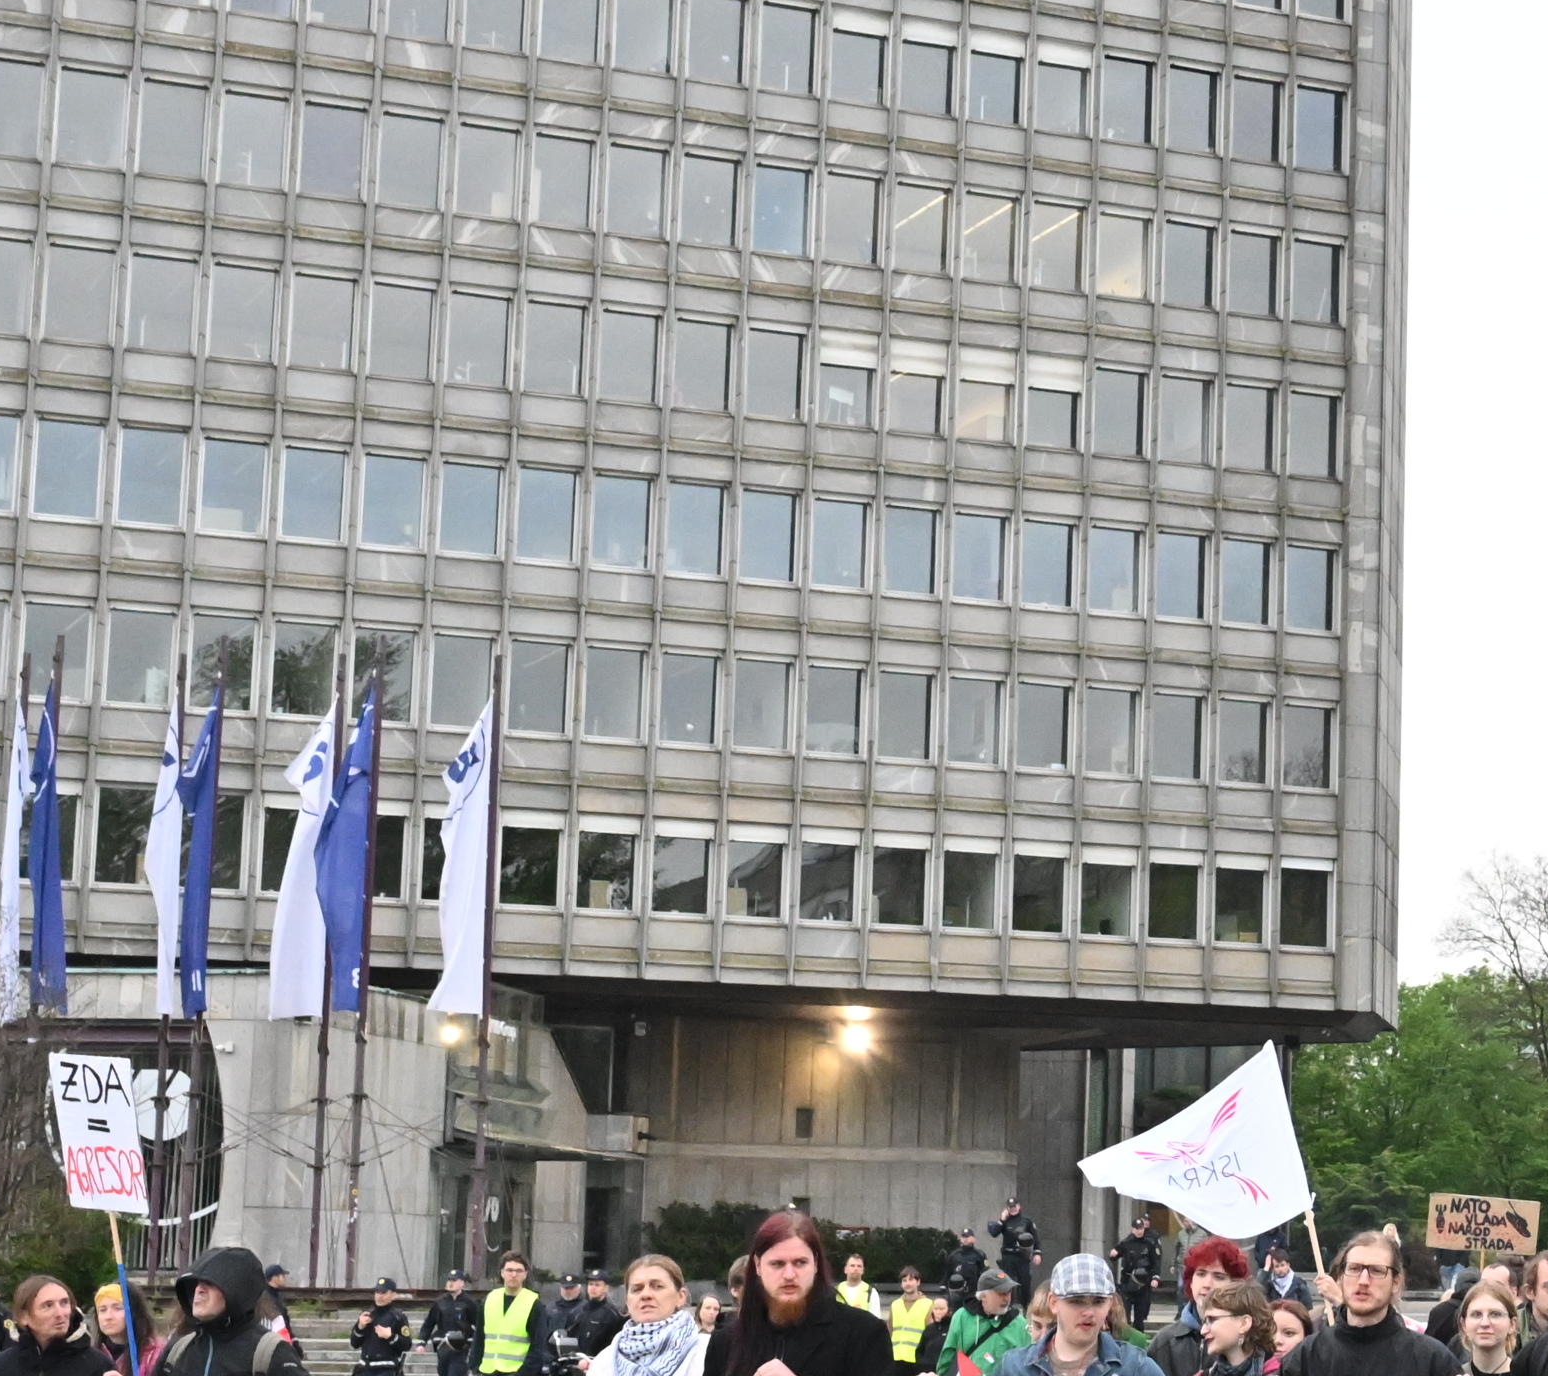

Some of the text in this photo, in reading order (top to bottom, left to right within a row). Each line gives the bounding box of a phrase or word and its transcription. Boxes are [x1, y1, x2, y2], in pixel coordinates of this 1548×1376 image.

[60, 1061, 131, 1107] ZDA
[66, 1145, 147, 1201] AGRESOR
[1450, 1198, 1491, 1214] NATO
[1465, 1212, 1507, 1228] VLADA
[1448, 1222, 1491, 1237] NAROD
[1464, 1237, 1514, 1251] STRADA
